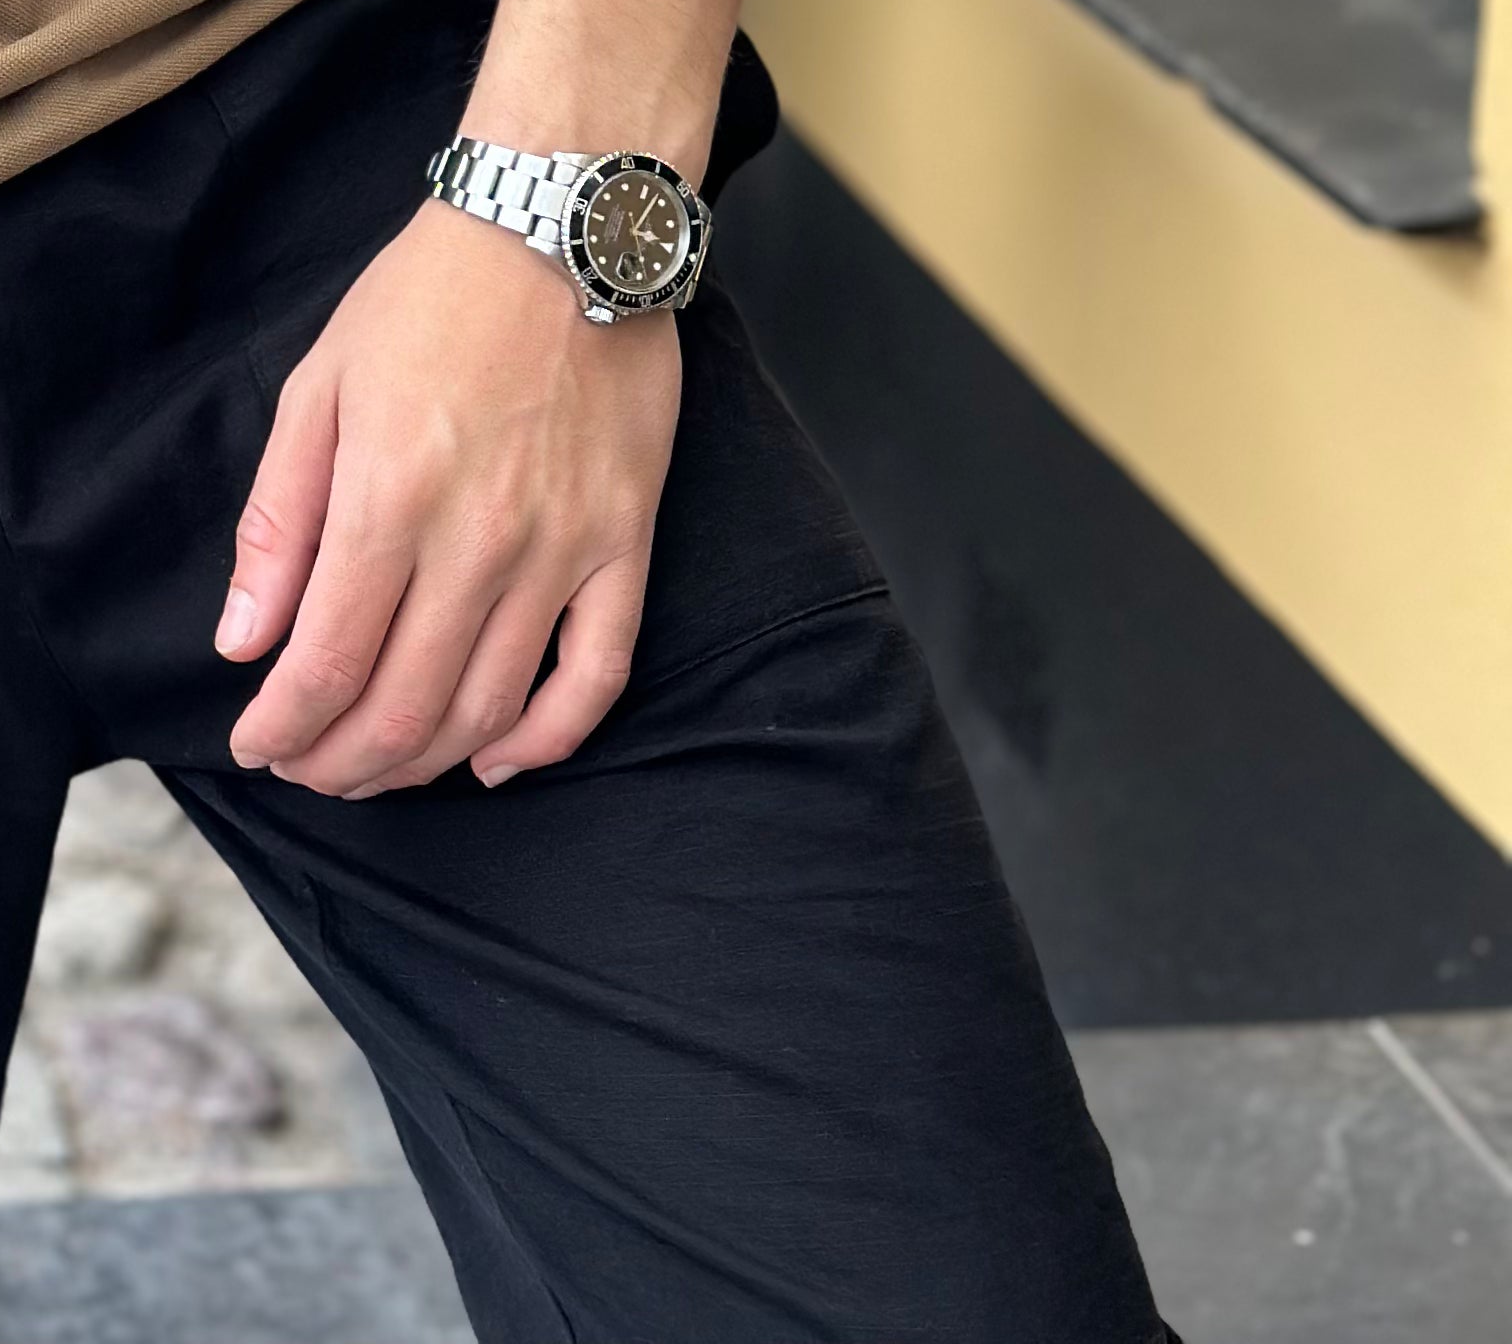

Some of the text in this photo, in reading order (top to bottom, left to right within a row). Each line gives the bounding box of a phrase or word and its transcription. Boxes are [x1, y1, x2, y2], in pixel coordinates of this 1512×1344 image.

[621, 156, 636, 170] 40
[573, 197, 589, 215] 30
[582, 267, 599, 284] 20
